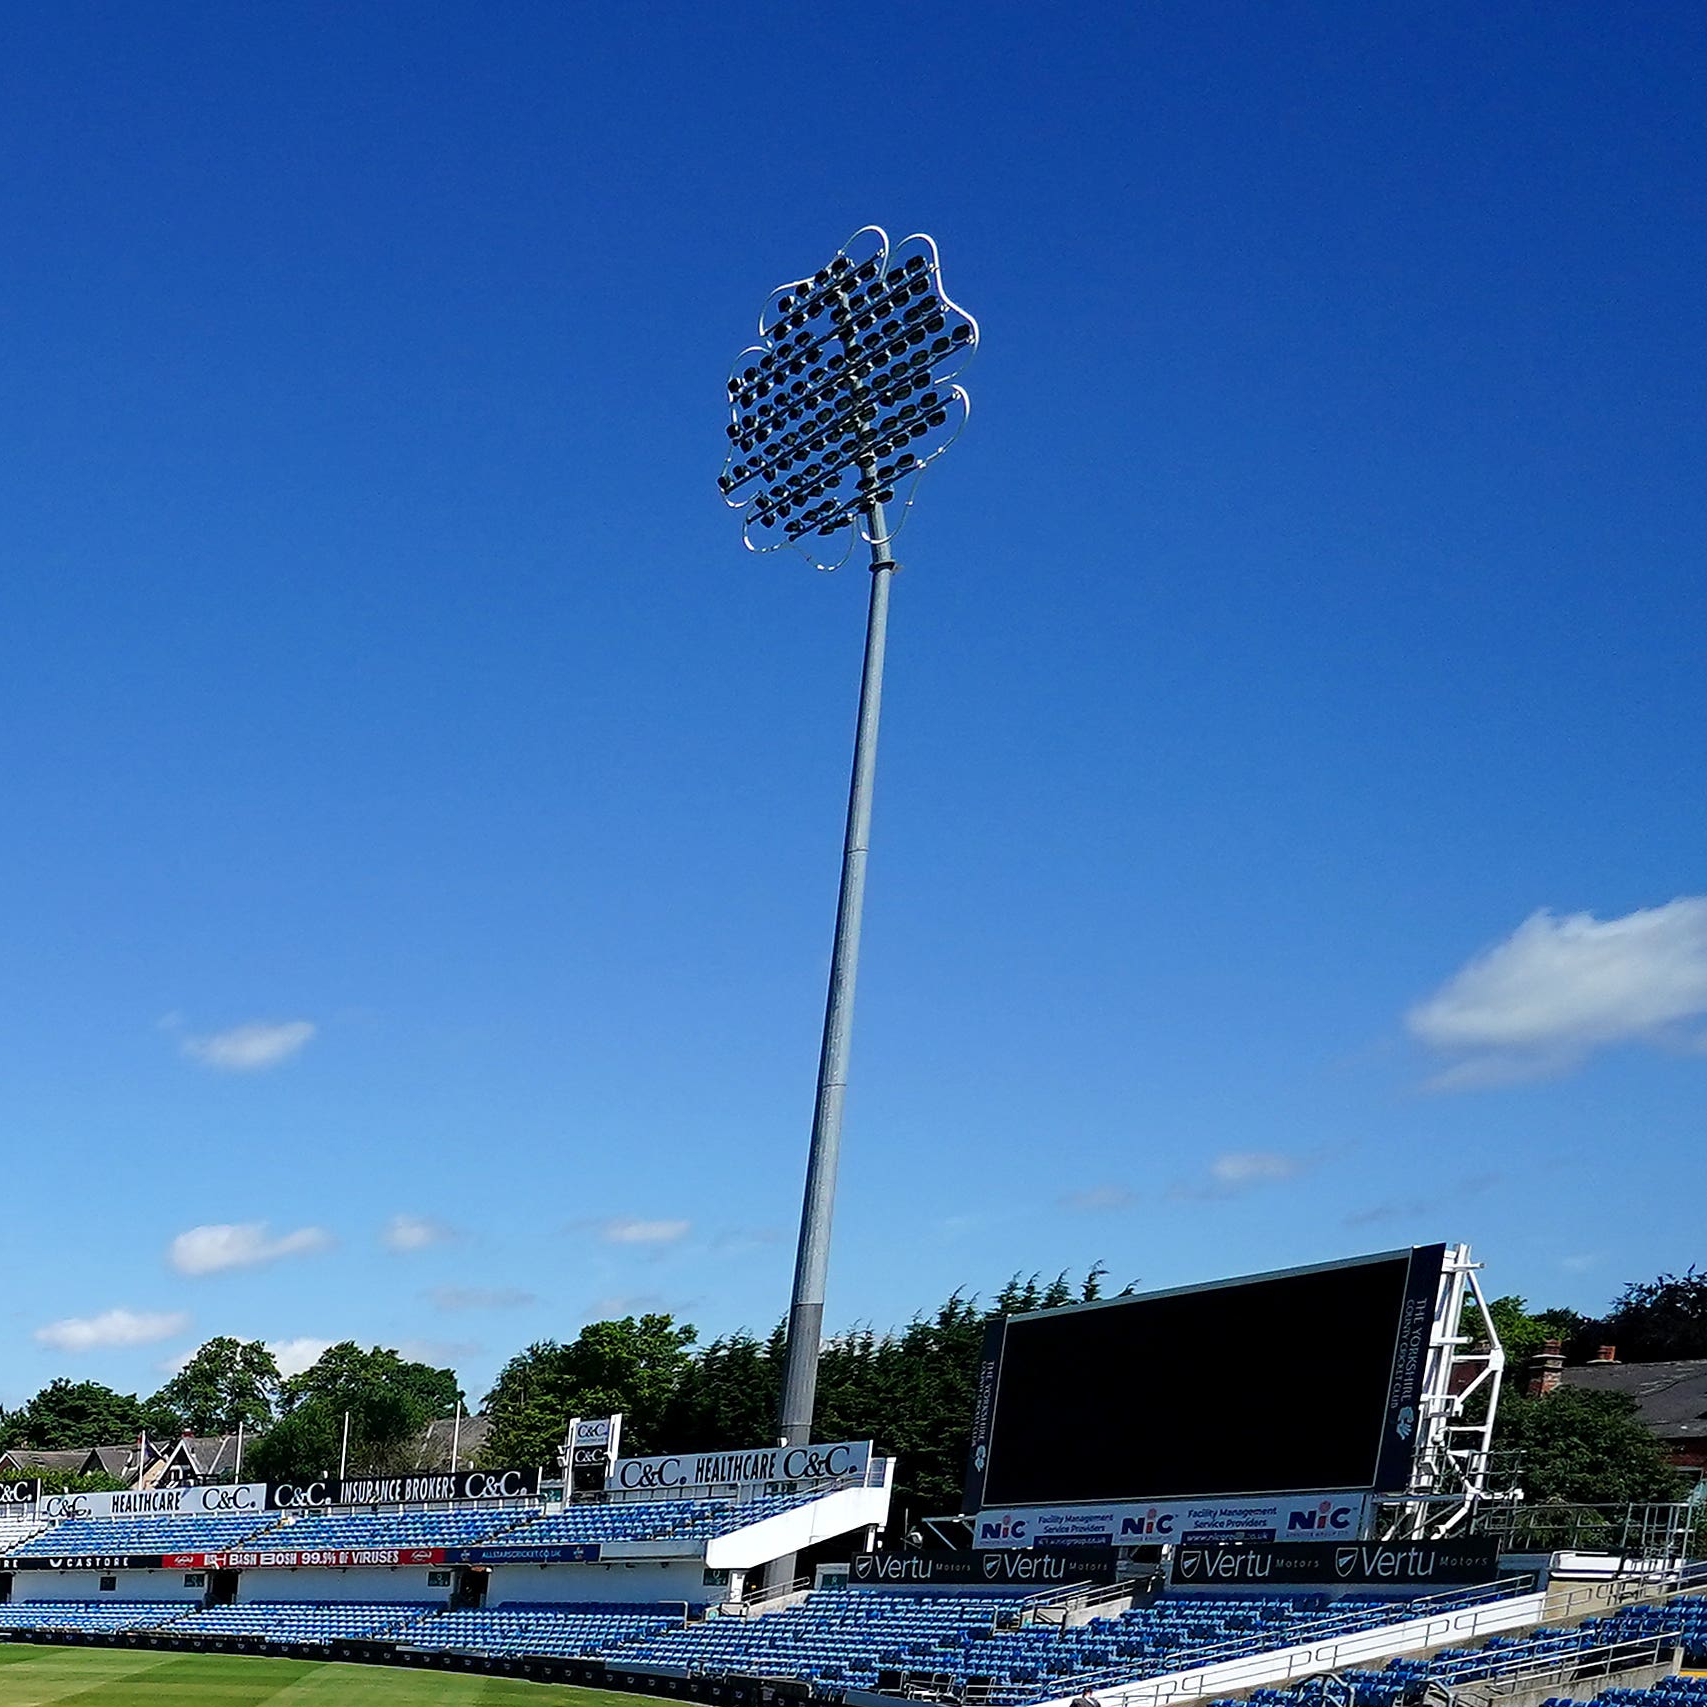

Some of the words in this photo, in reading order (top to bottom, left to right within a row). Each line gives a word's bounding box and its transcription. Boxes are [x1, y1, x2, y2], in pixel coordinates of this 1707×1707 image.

[1413, 1297, 1428, 1324] THE
[1400, 1327, 1422, 1402] YORKSHIRE
[620, 1459, 686, 1488] C&C.
[695, 1453, 776, 1484] HEALTHCARE
[783, 1446, 857, 1479] C&C.
[111, 1491, 180, 1513] HEALTHCARE
[202, 1486, 256, 1510] C&C.
[274, 1482, 332, 1507] C&C.
[340, 1478, 401, 1504] INSURANCE
[405, 1476, 456, 1501] BROKERS
[464, 1471, 527, 1498] C&C.
[1038, 1515, 1063, 1525] Facility
[1065, 1513, 1114, 1524] Management
[1187, 1508, 1217, 1519] Facility
[1219, 1506, 1277, 1518] Management
[1194, 1520, 1224, 1529] Service
[1226, 1518, 1267, 1528] Providers
[1043, 1525, 1070, 1534] Service
[1071, 1523, 1106, 1532] Providers
[67, 1557, 129, 1567] CASTORE
[351, 1551, 399, 1564] VIRUSES
[875, 1554, 933, 1579] Vertu
[936, 1563, 971, 1572] Motors
[1004, 1554, 1066, 1579] Vertu
[1069, 1562, 1108, 1571] Motors
[1204, 1549, 1272, 1578] Vertu
[1275, 1558, 1319, 1568] Motors
[1361, 1546, 1436, 1577] Vertu
[1439, 1555, 1488, 1566] Motors
